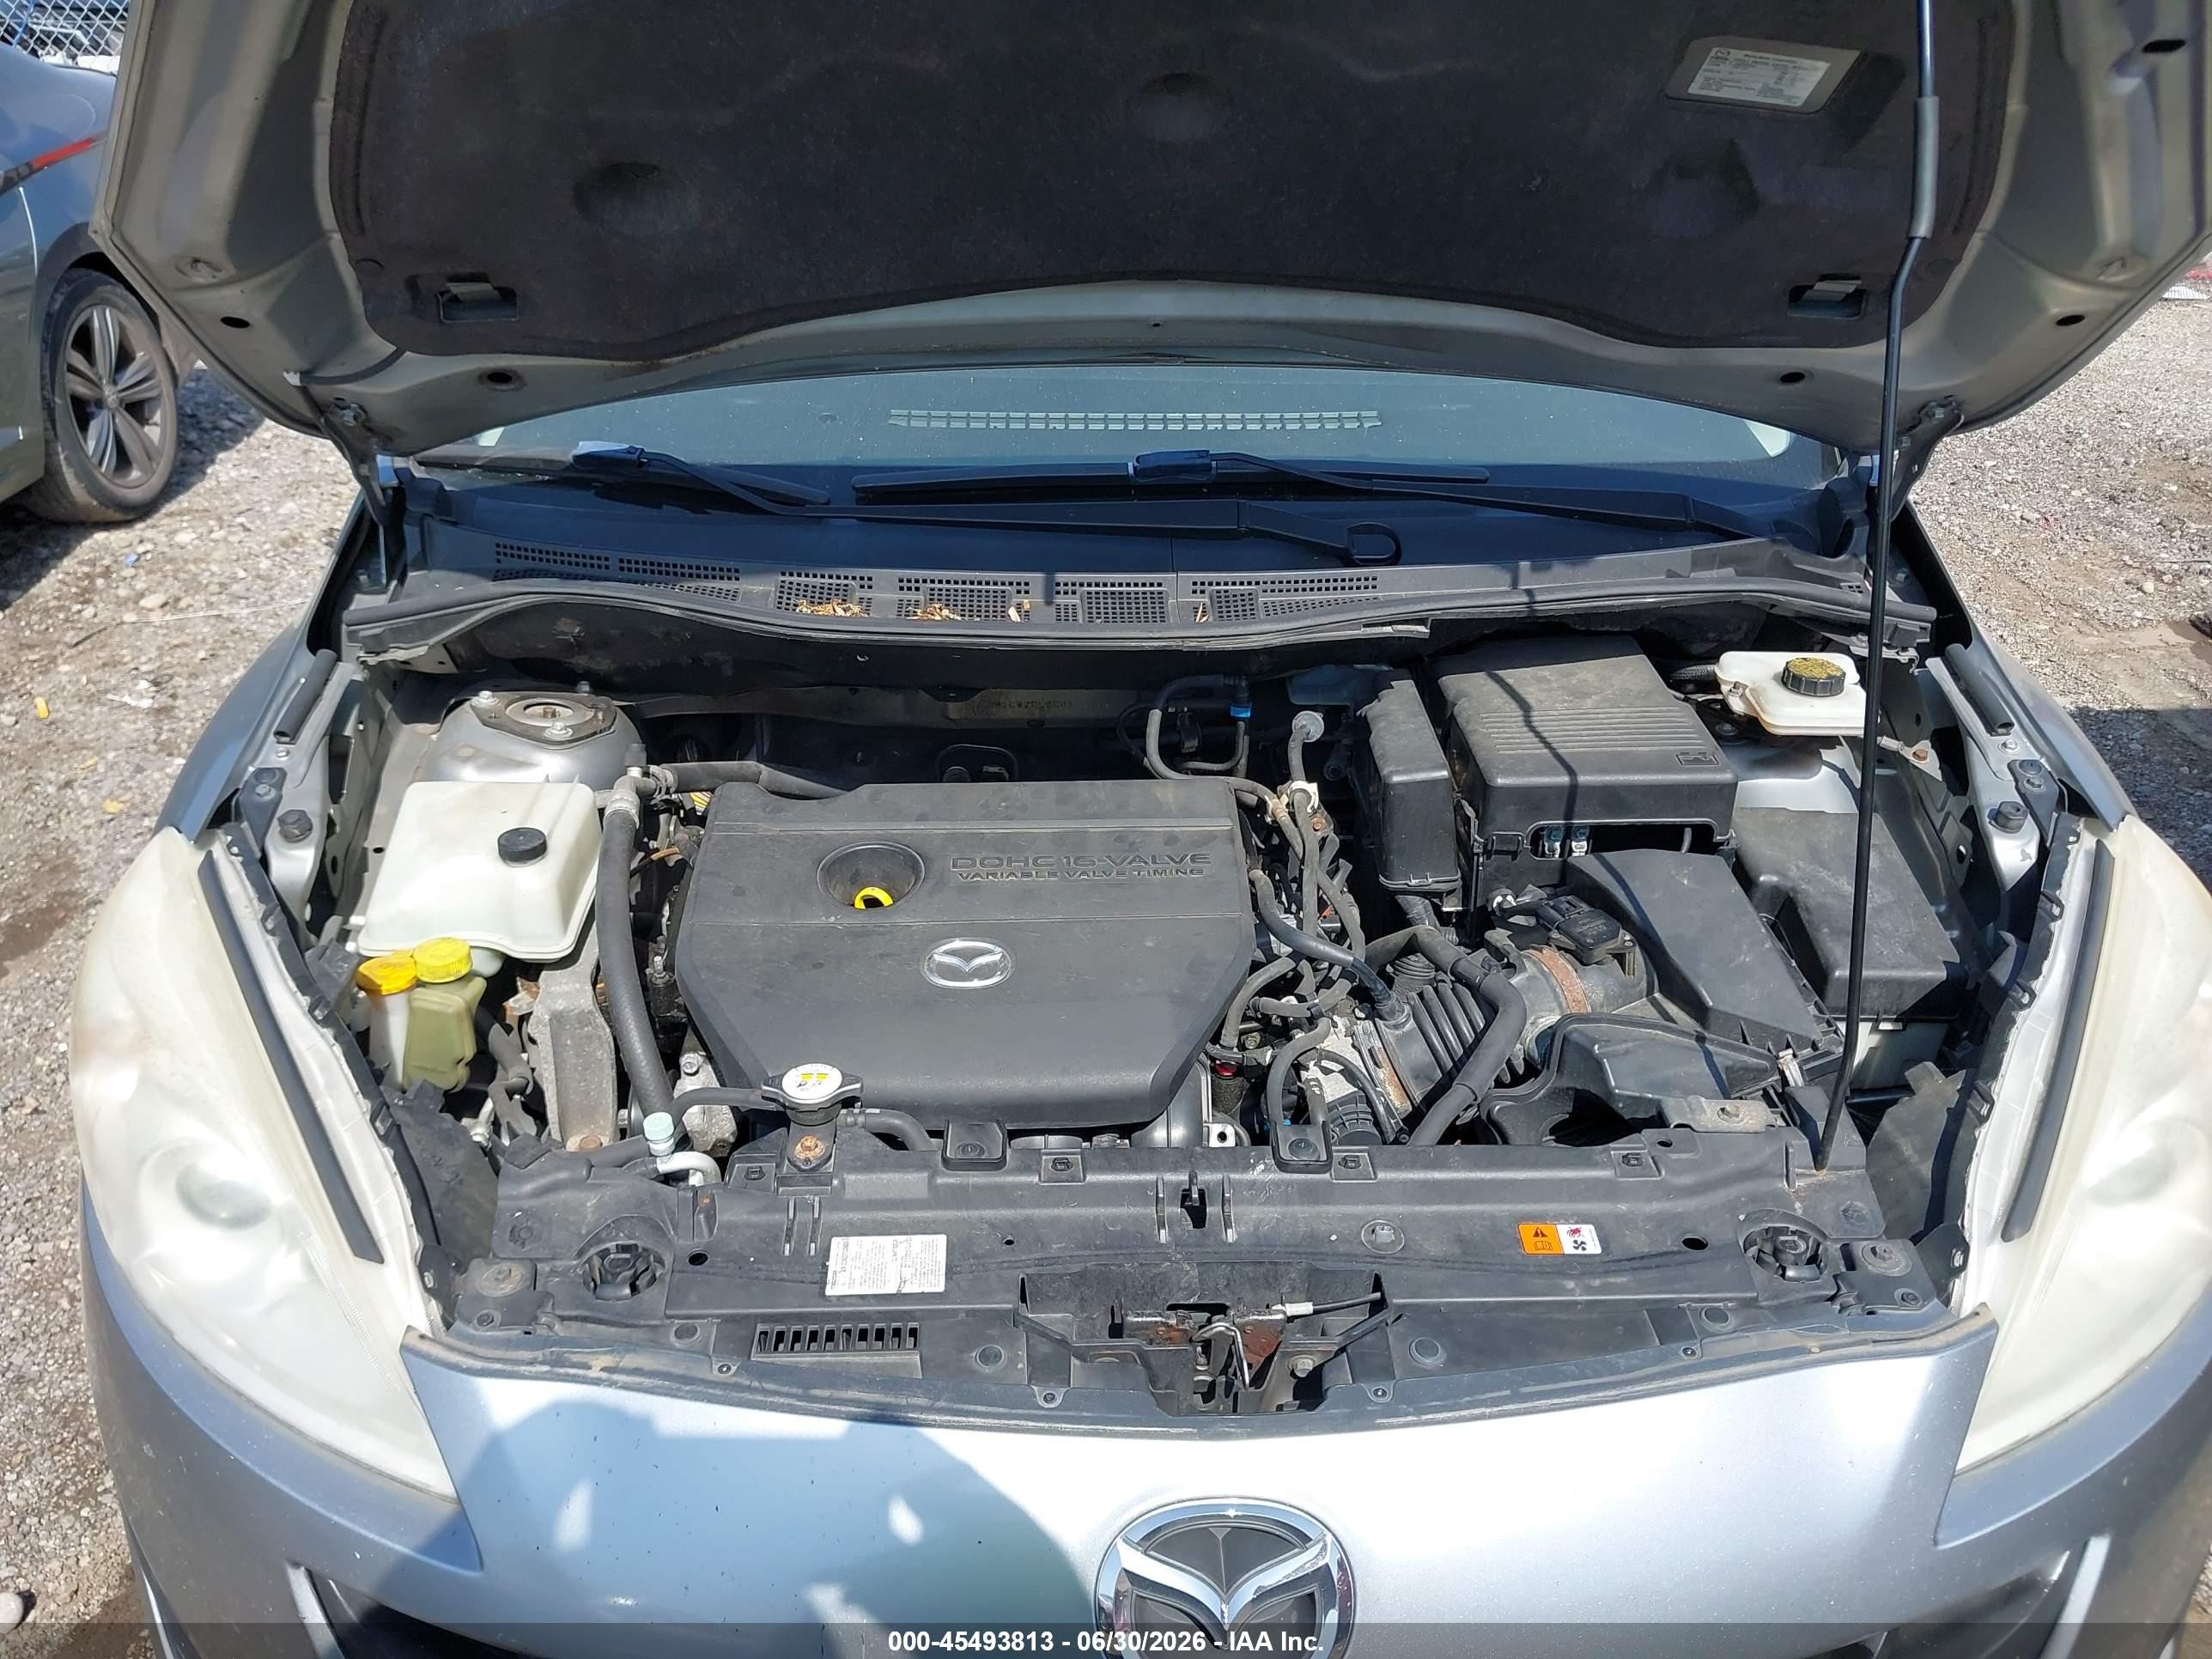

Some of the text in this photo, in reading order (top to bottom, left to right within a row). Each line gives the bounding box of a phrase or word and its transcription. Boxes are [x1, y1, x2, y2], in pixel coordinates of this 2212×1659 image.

[951, 853, 1212, 870] DOHC 16-VALVE
[957, 868, 1206, 881] VARIABLE VALVE TIMING
